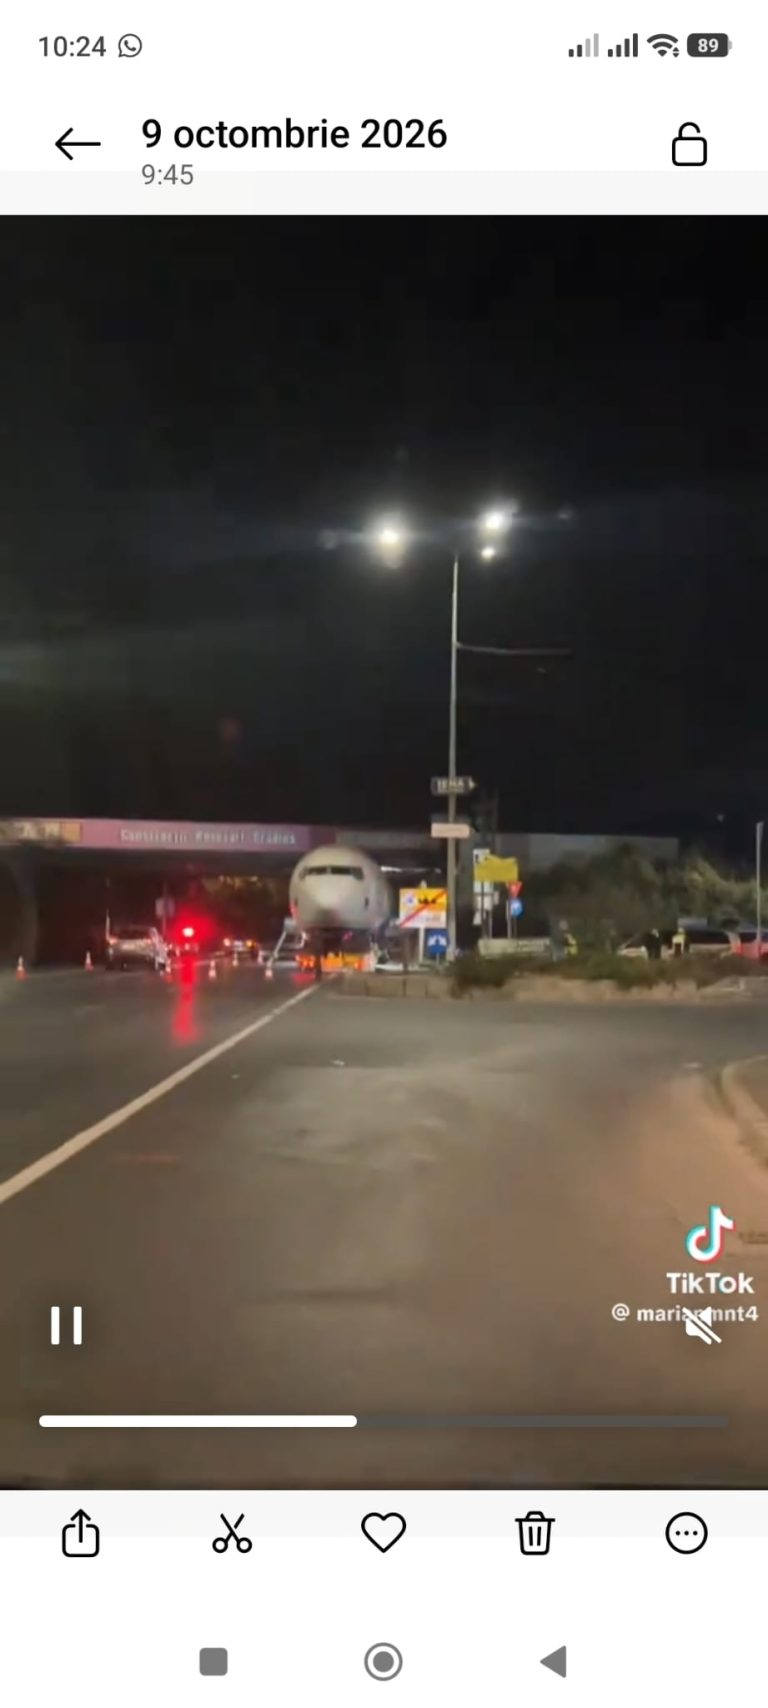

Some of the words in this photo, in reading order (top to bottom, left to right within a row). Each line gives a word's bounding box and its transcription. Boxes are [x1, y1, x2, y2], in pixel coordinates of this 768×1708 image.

[38, 36, 107, 57] 10:24
[698, 38, 719, 53] 89
[142, 118, 162, 149] 9
[173, 117, 350, 149] octombrie
[360, 118, 448, 149] 2026
[141, 163, 194, 186] 9:45
